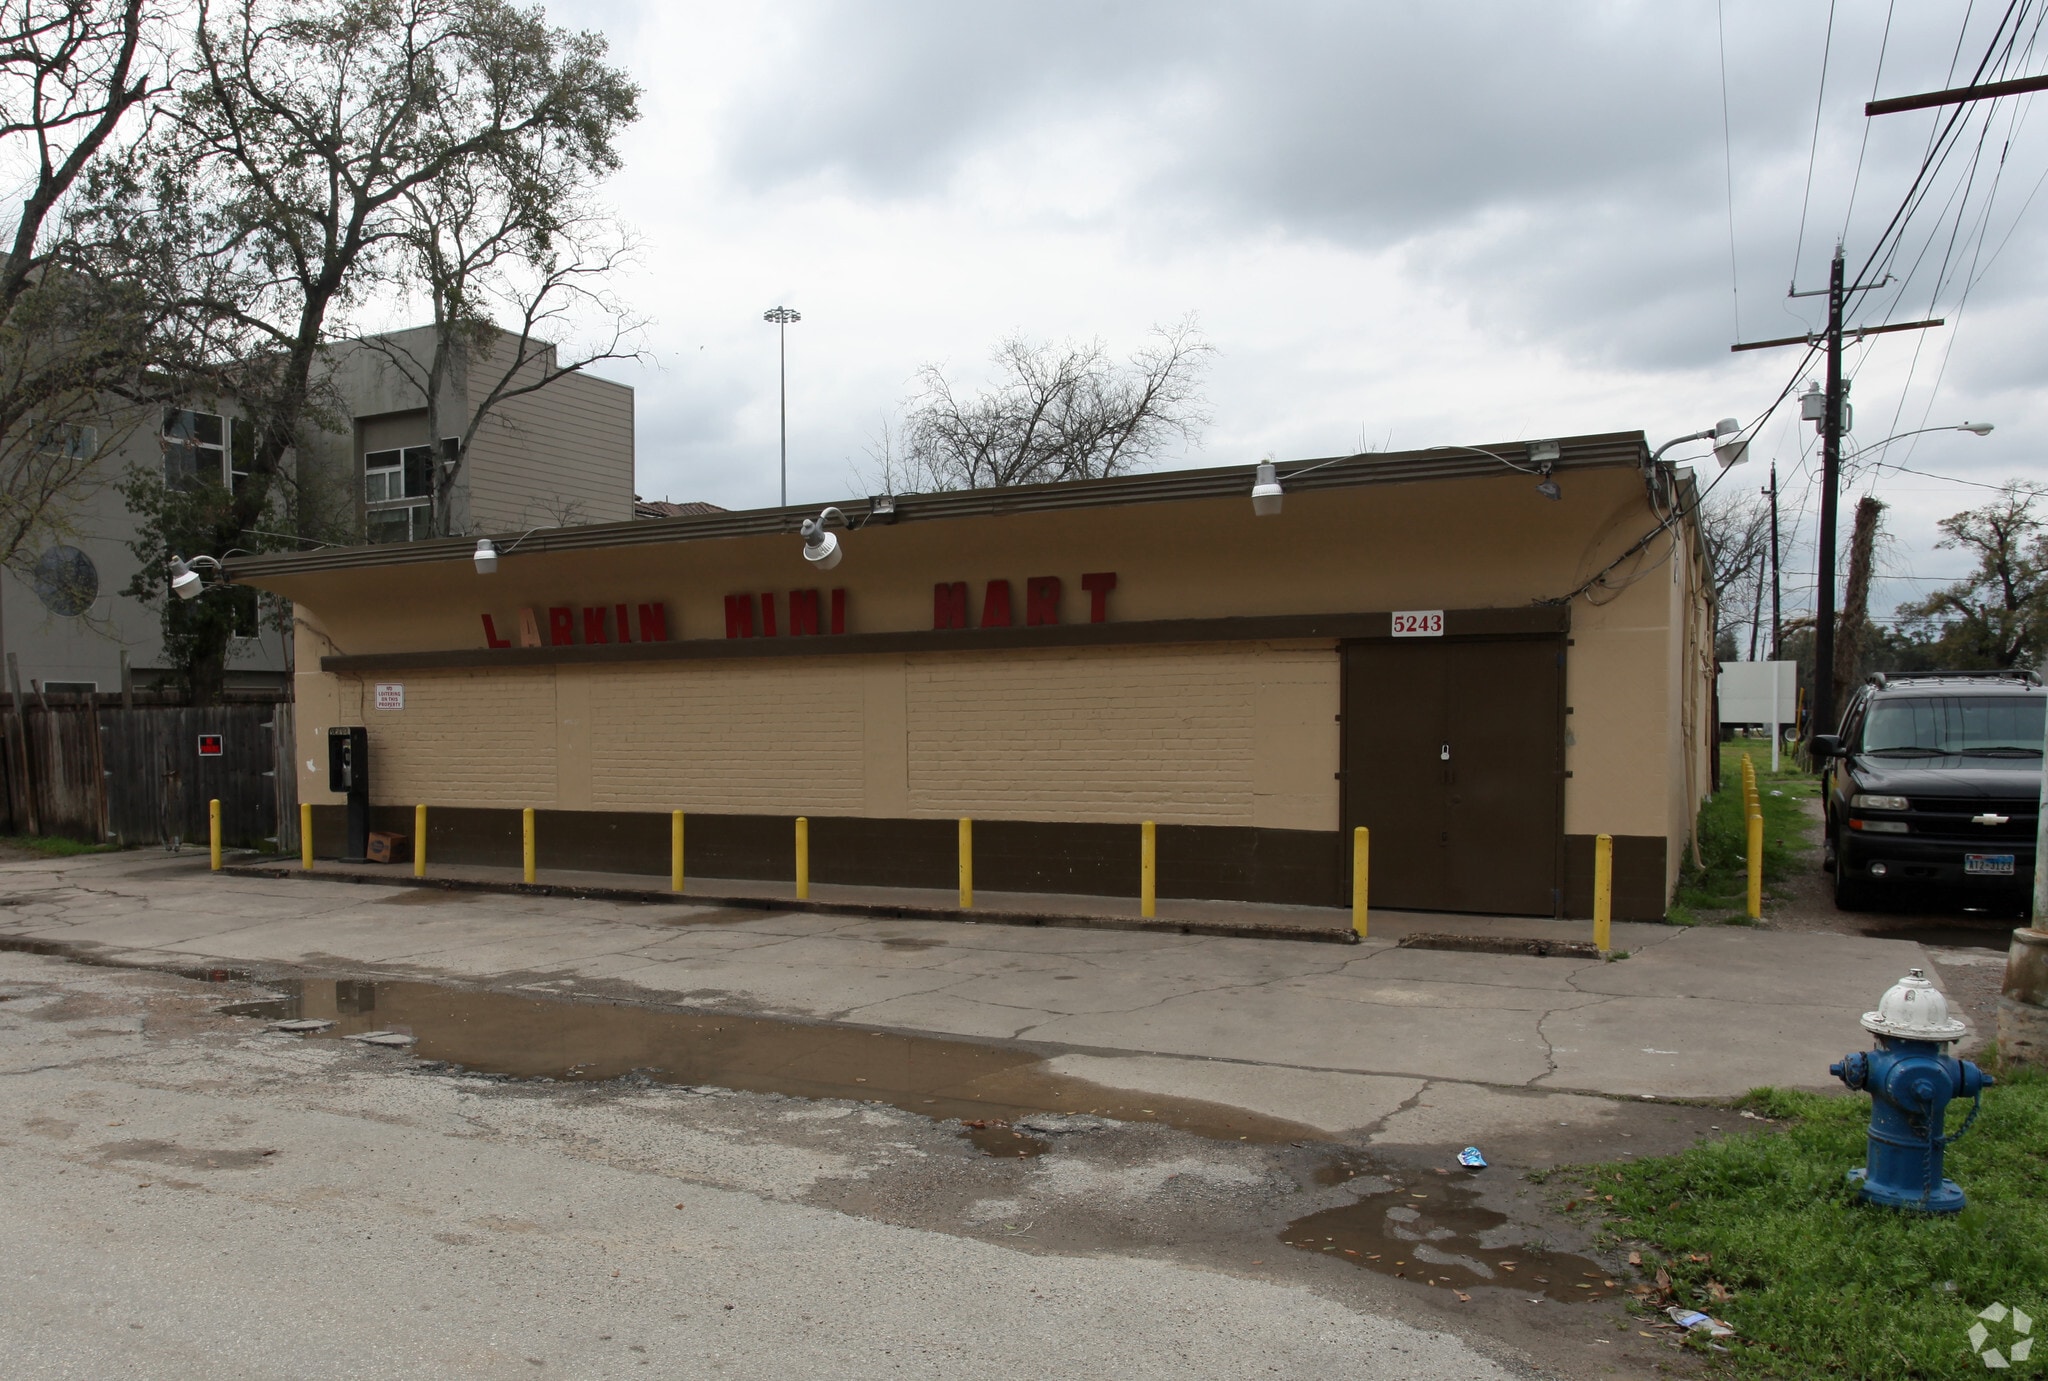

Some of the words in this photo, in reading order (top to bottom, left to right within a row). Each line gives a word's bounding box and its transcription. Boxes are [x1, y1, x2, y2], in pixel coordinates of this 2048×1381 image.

[481, 602, 667, 648] LARKIN
[724, 588, 846, 639] MINI
[934, 572, 1117, 630] MART
[1394, 614, 1442, 632] 5243
